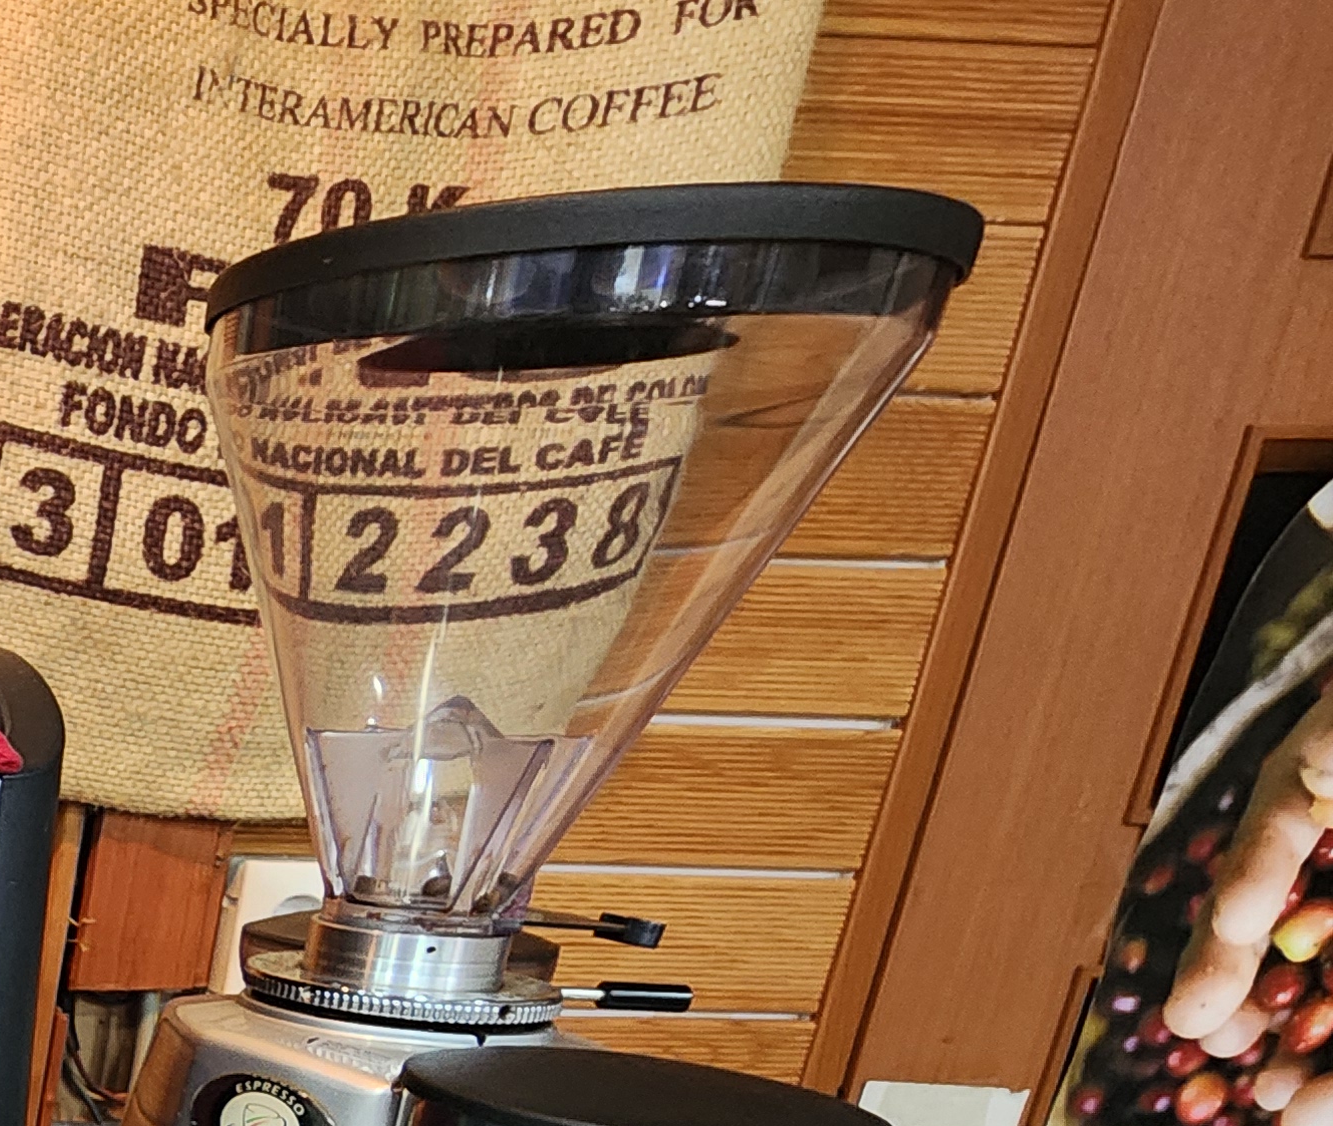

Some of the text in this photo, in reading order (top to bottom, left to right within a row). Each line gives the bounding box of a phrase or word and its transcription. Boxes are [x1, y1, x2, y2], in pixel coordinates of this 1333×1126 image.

[421, 8, 641, 57] PREPARED
[192, 64, 722, 138] INTERAMERICAN COFFEE
[267, 172, 372, 243] 70
[58, 381, 206, 453] FONDO
[251, 437, 425, 478] NACIONAL
[441, 447, 521, 476] DEL
[11, 467, 75, 557] 3
[235, 1080, 306, 1116] ESPRESSO
